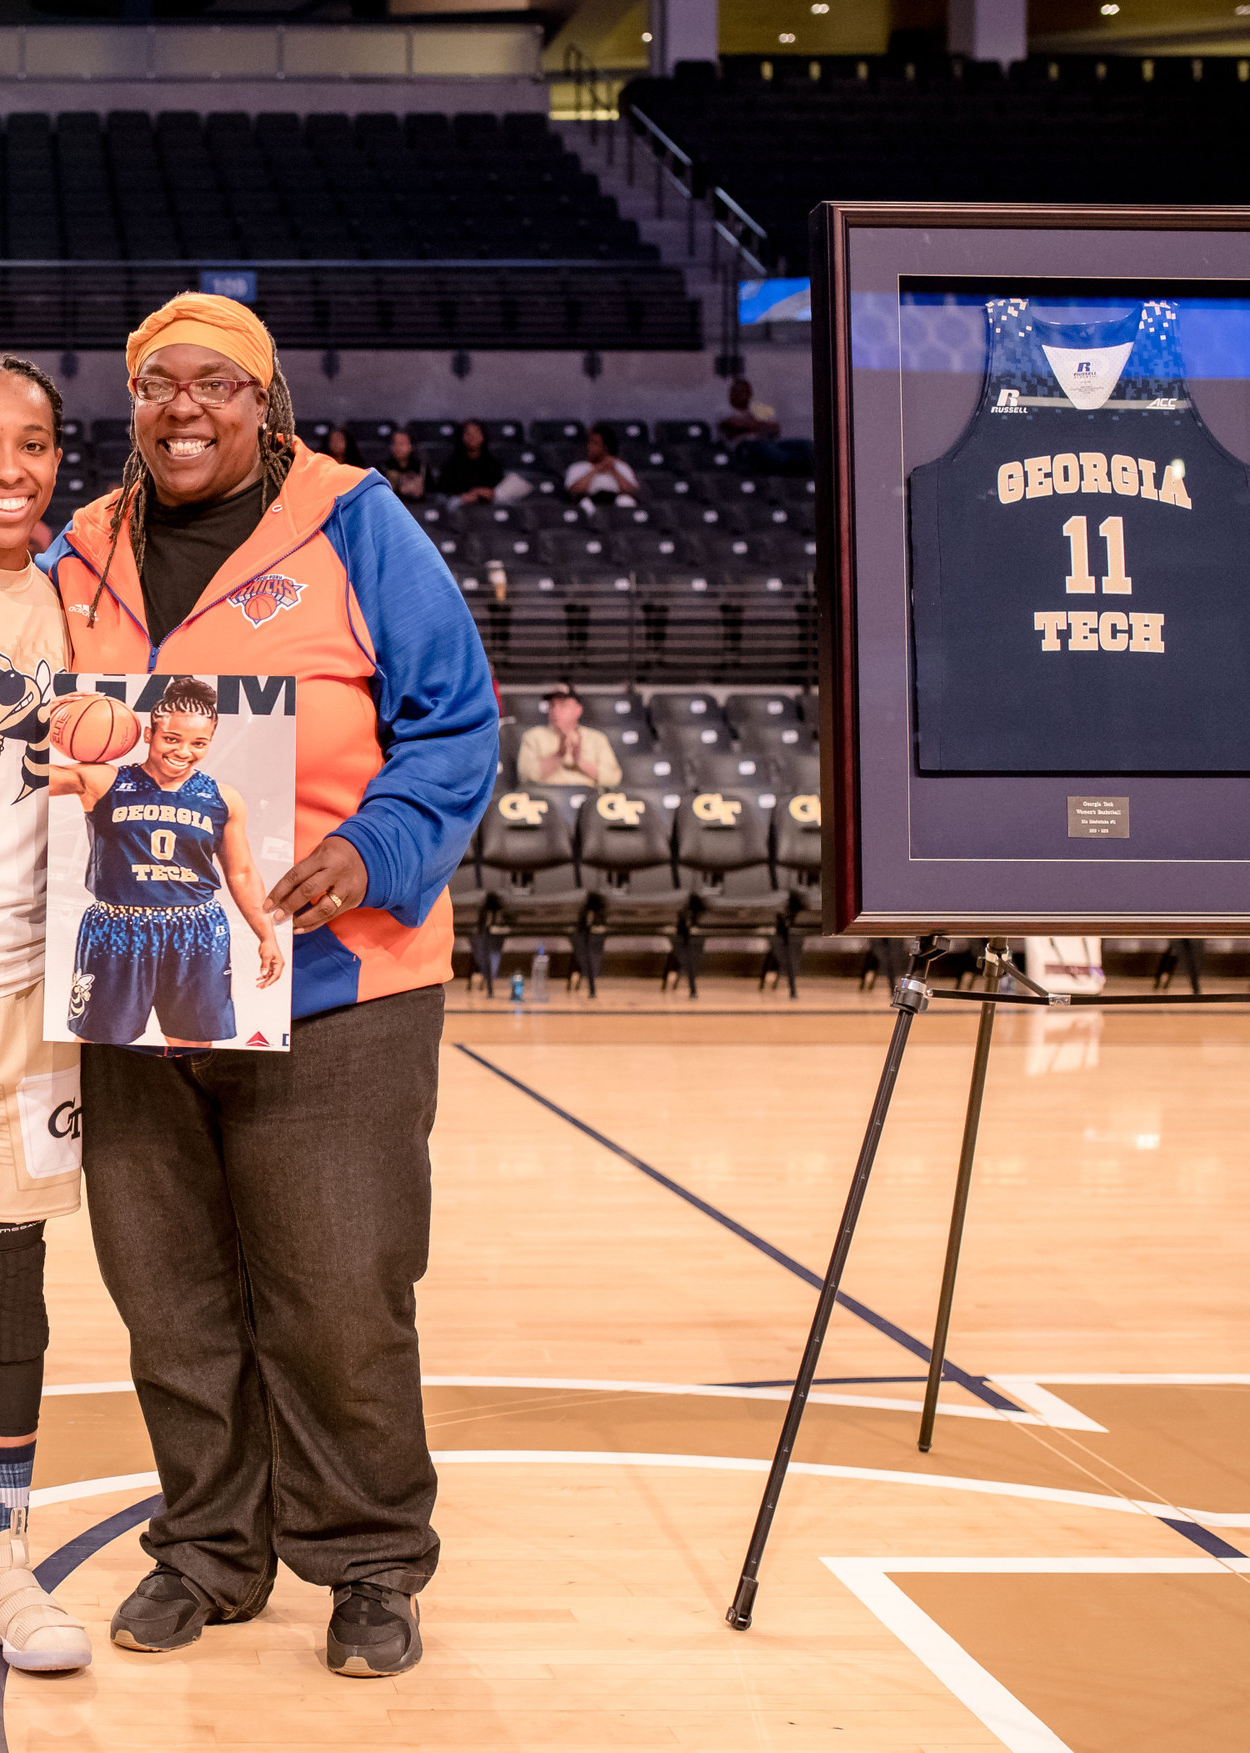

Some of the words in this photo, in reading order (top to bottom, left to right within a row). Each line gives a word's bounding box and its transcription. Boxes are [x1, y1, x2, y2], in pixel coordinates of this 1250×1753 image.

[1146, 398, 1177, 410] ACC
[998, 452, 1193, 510] GEORGIA
[1062, 515, 1133, 595] 11
[68, 605, 100, 621] adid
[1034, 611, 1165, 654] TECH
[112, 804, 214, 835] GEORGIA
[151, 829, 177, 861] 0
